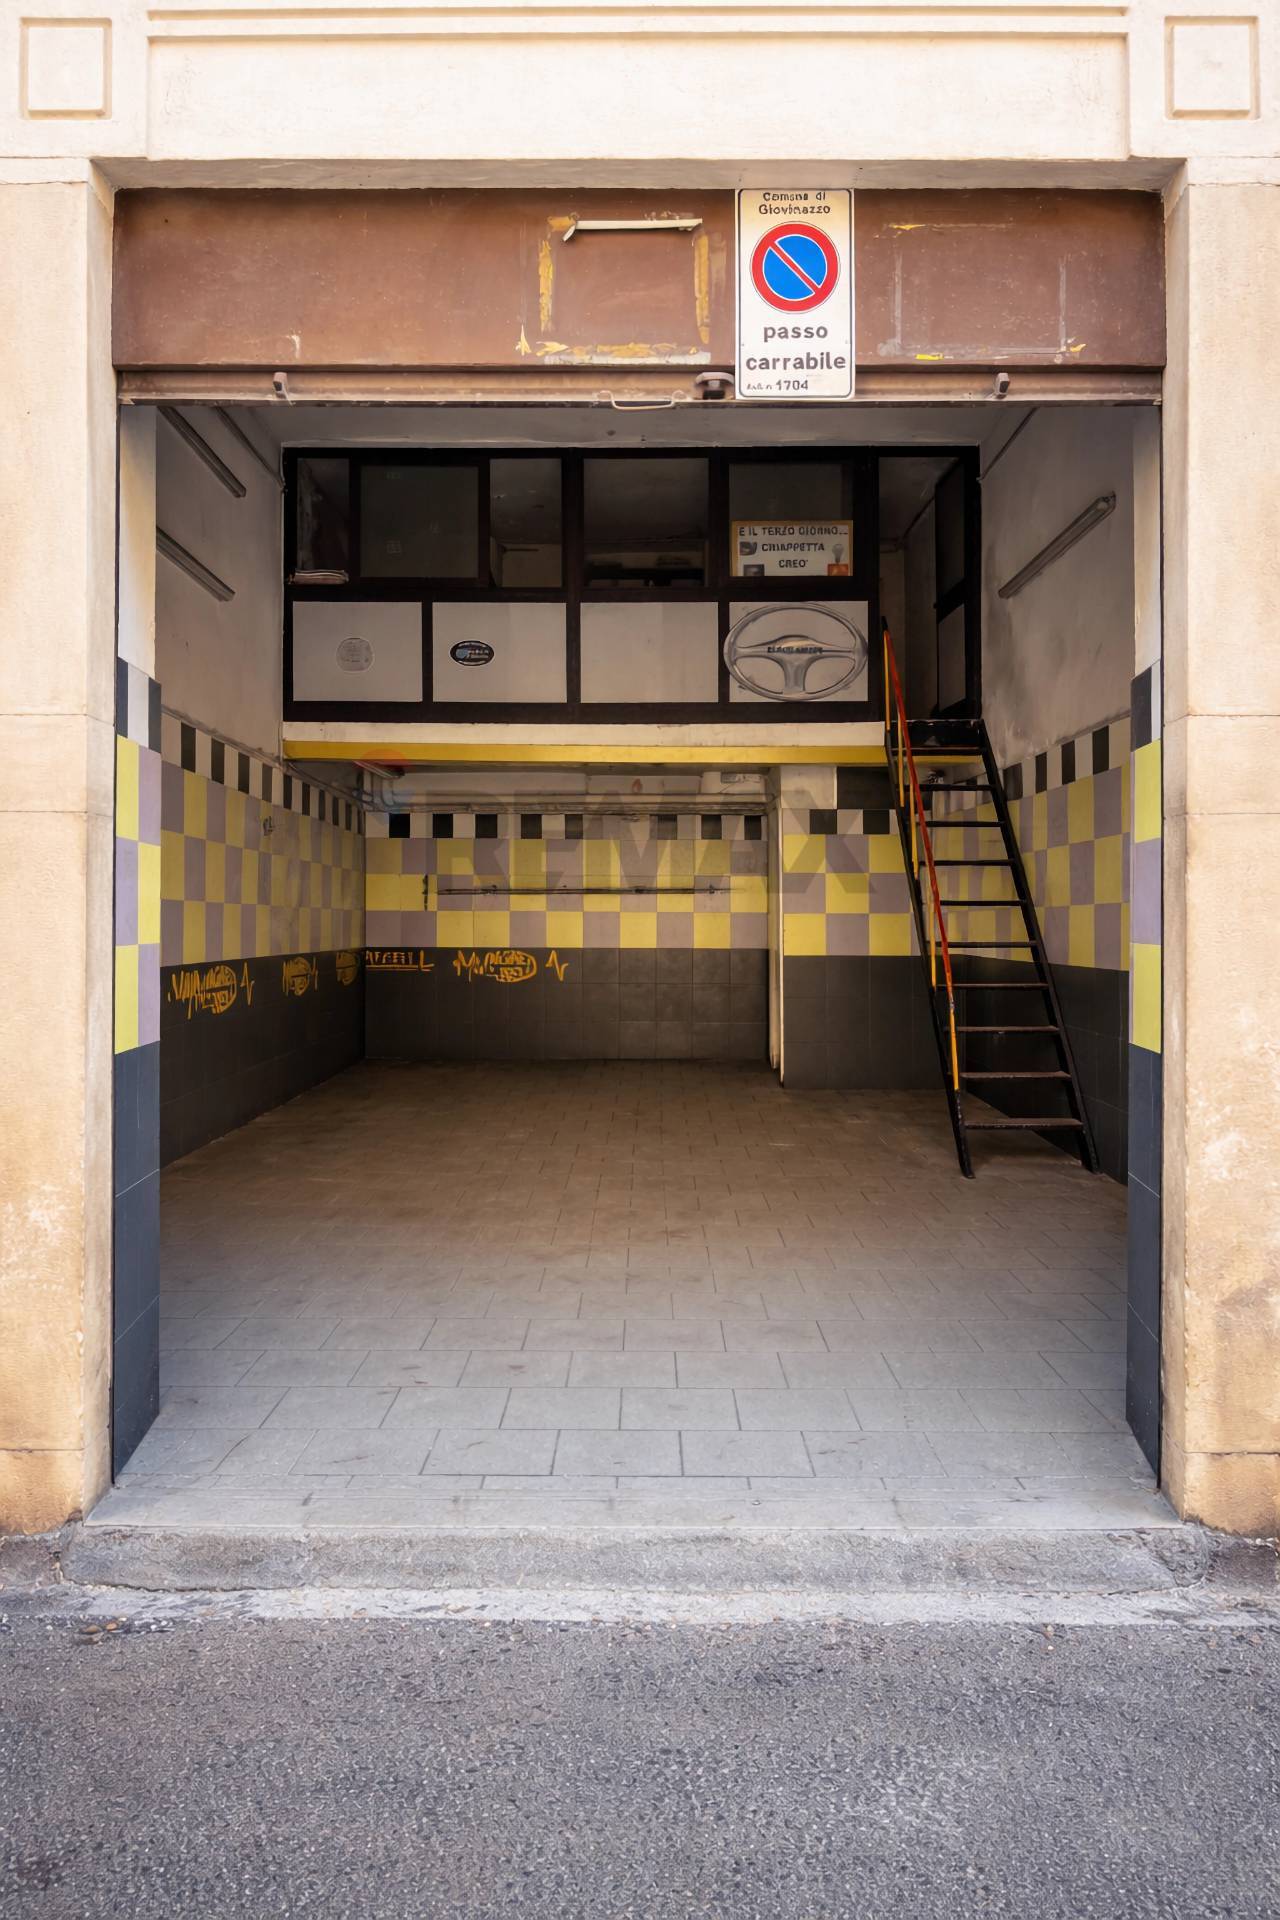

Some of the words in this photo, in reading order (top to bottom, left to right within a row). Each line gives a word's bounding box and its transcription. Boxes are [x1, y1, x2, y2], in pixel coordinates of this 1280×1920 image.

[815, 191, 826, 201] di
[758, 203, 831, 215] Giovinazzo
[763, 326, 828, 343] passo
[745, 351, 846, 370] carrabile
[776, 379, 808, 390] 1704
[748, 527, 758, 536] IL
[762, 527, 794, 536] TERZO
[762, 543, 824, 552] CHIAPPETTA
